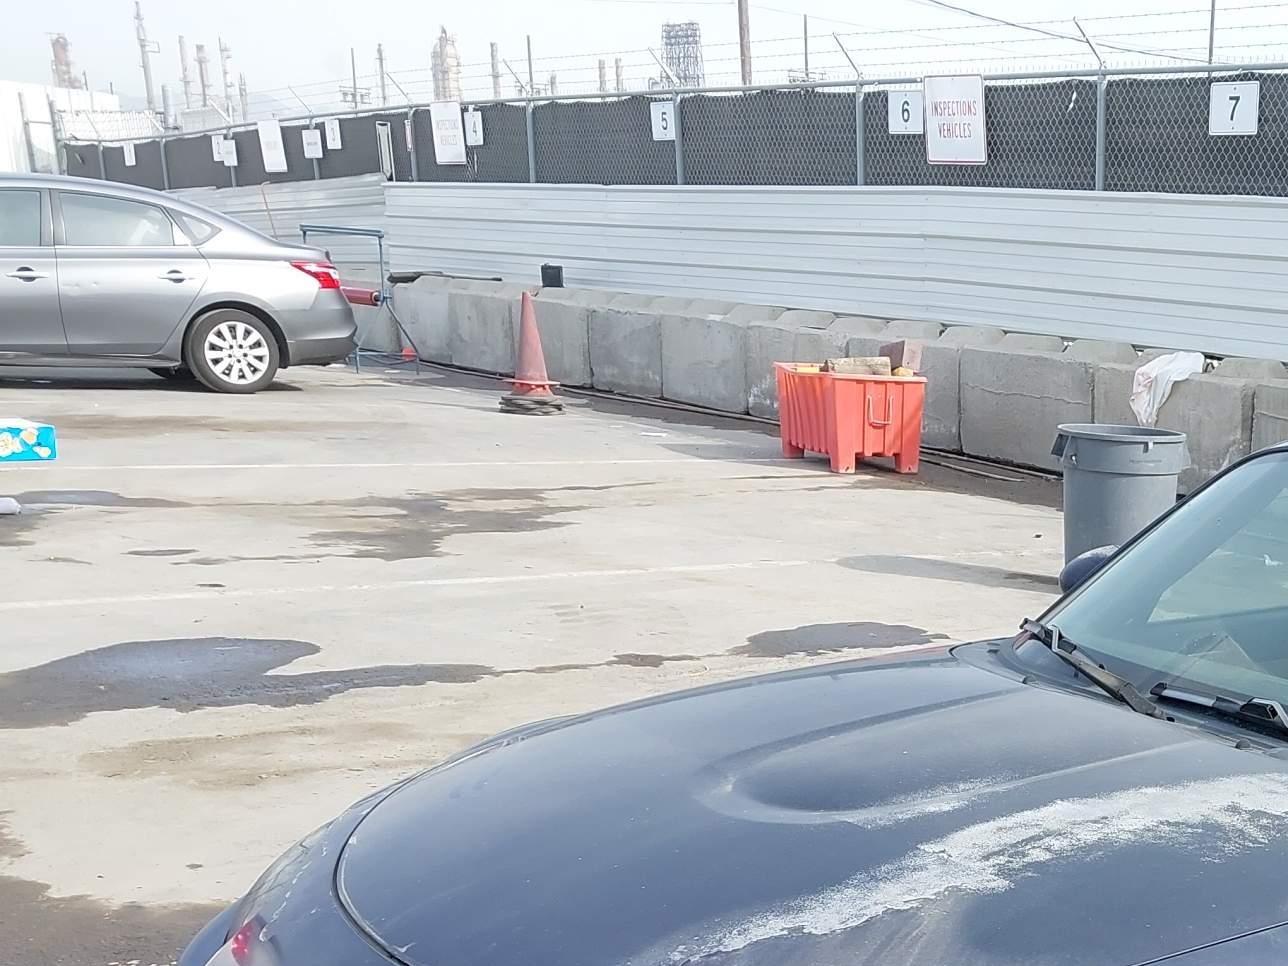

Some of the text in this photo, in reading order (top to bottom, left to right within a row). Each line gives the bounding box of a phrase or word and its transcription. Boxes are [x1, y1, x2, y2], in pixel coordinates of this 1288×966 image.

[901, 100, 911, 123] 6
[931, 100, 977, 117] INSPECTIONS
[1229, 95, 1240, 121] 7
[472, 120, 478, 137] 4
[660, 111, 668, 130] 5
[938, 122, 972, 138] VEHICLES
